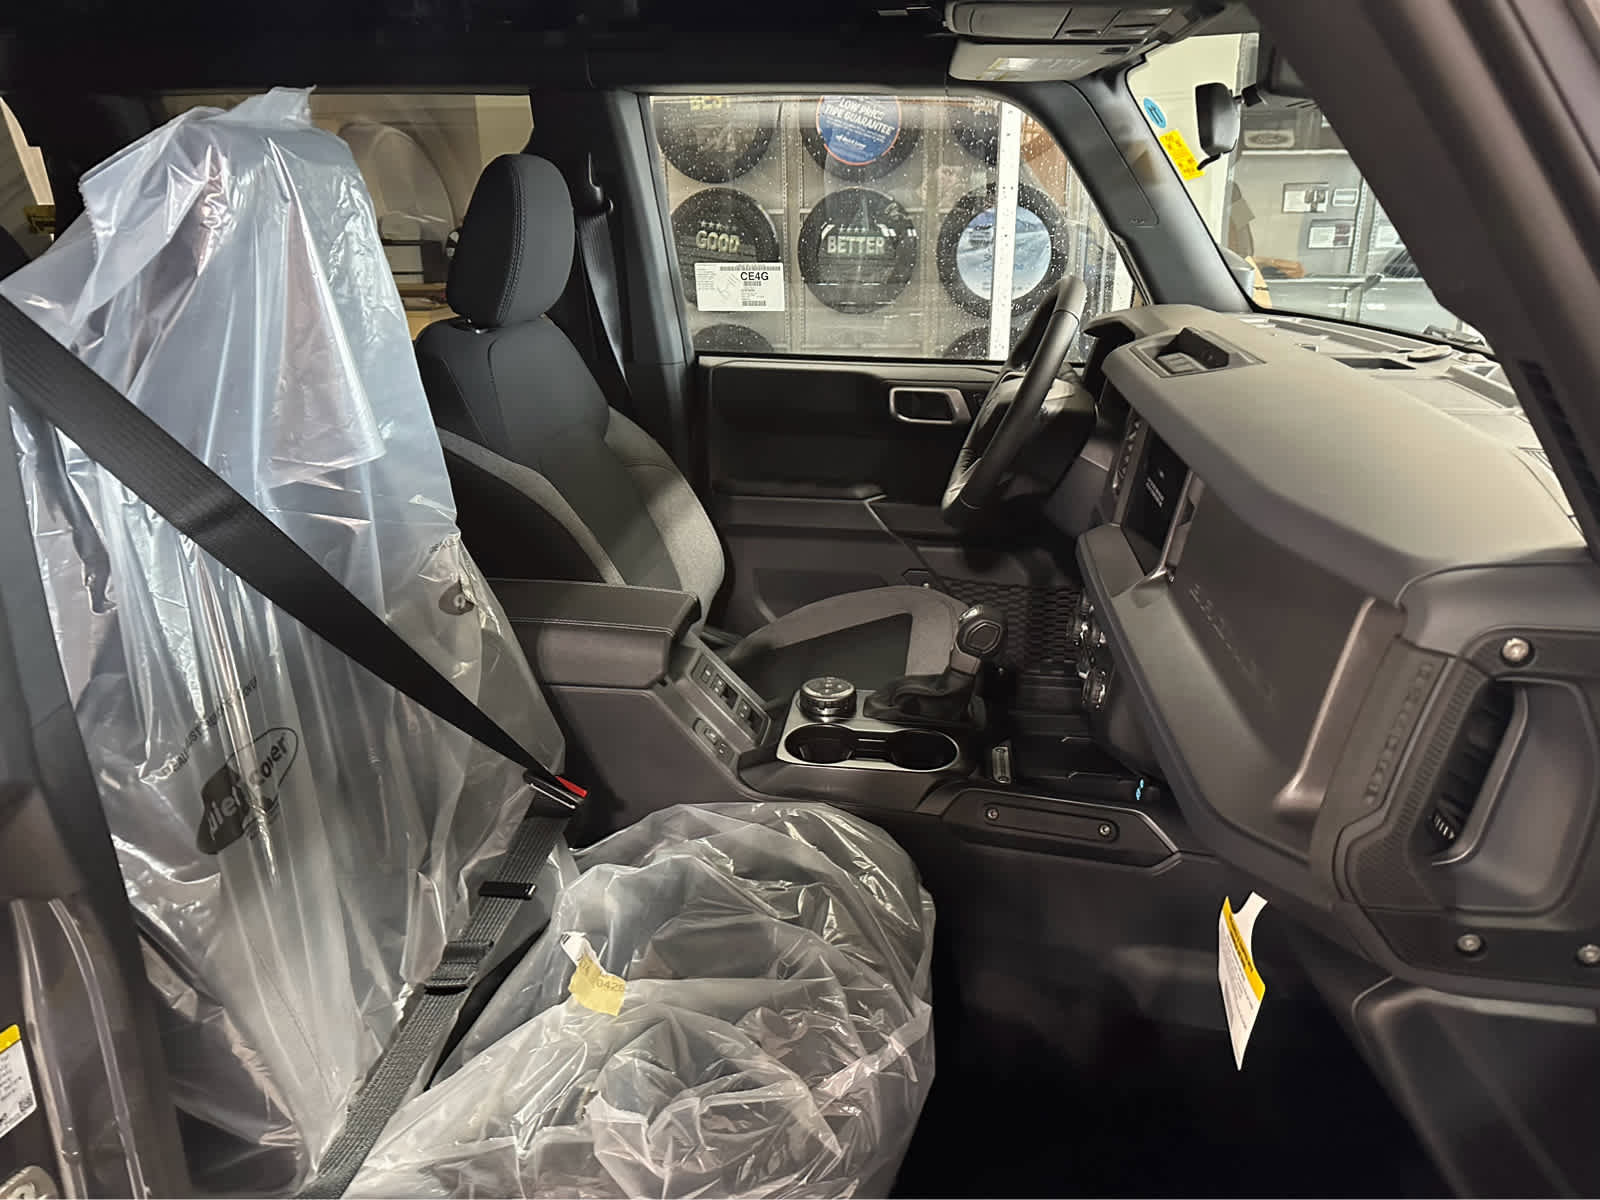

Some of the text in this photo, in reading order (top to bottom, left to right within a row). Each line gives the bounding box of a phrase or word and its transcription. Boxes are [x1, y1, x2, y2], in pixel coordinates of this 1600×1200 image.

[695, 230, 741, 253] GOOD
[827, 236, 885, 255] BETTER
[740, 271, 769, 281] CE4G
